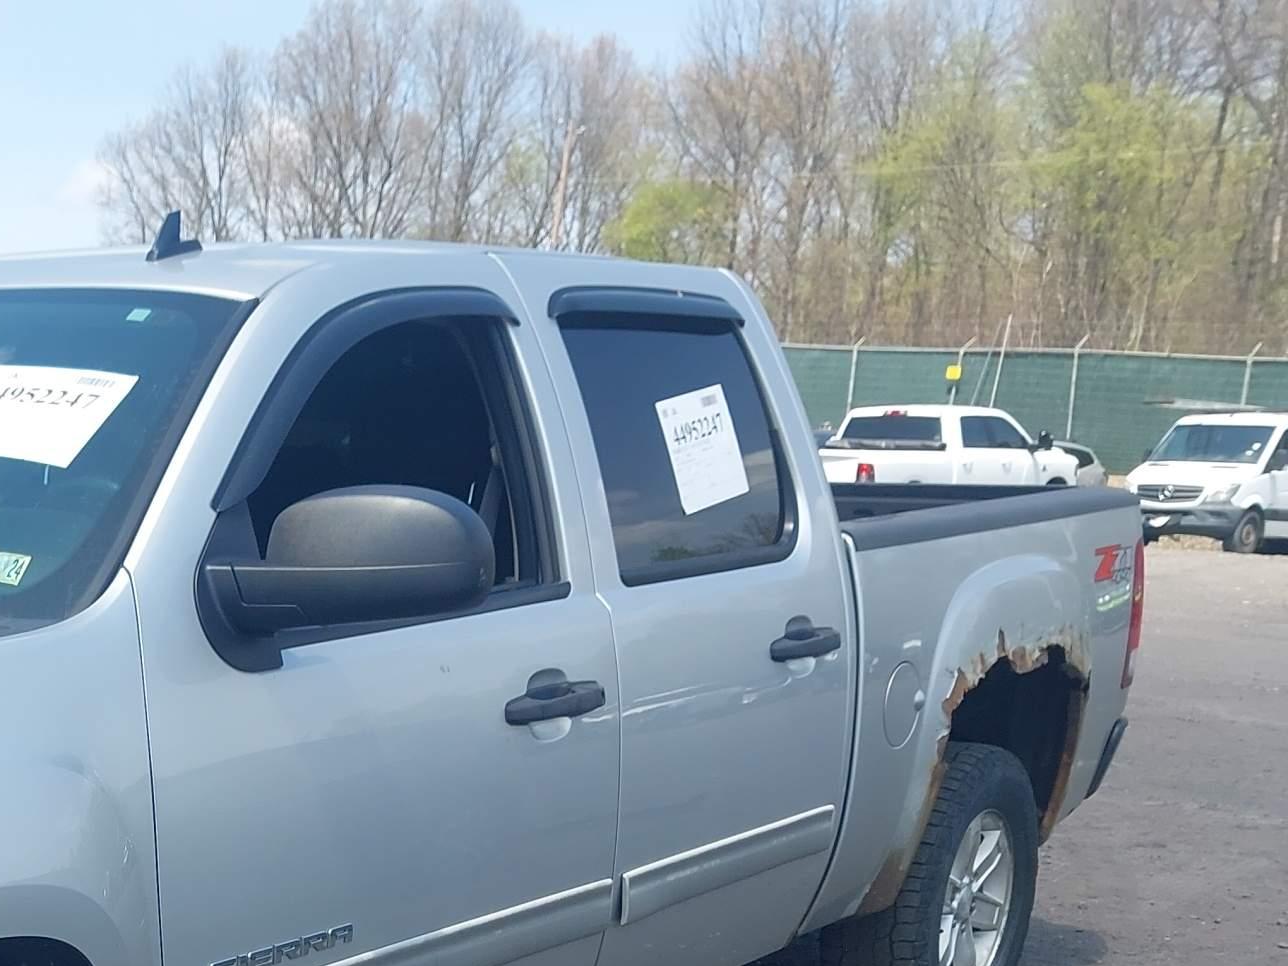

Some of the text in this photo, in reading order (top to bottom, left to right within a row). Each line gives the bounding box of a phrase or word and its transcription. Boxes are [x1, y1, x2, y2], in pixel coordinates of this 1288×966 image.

[673, 412, 724, 446] 44952247
[6, 559, 26, 580] 24
[1095, 544, 1133, 583] Z71
